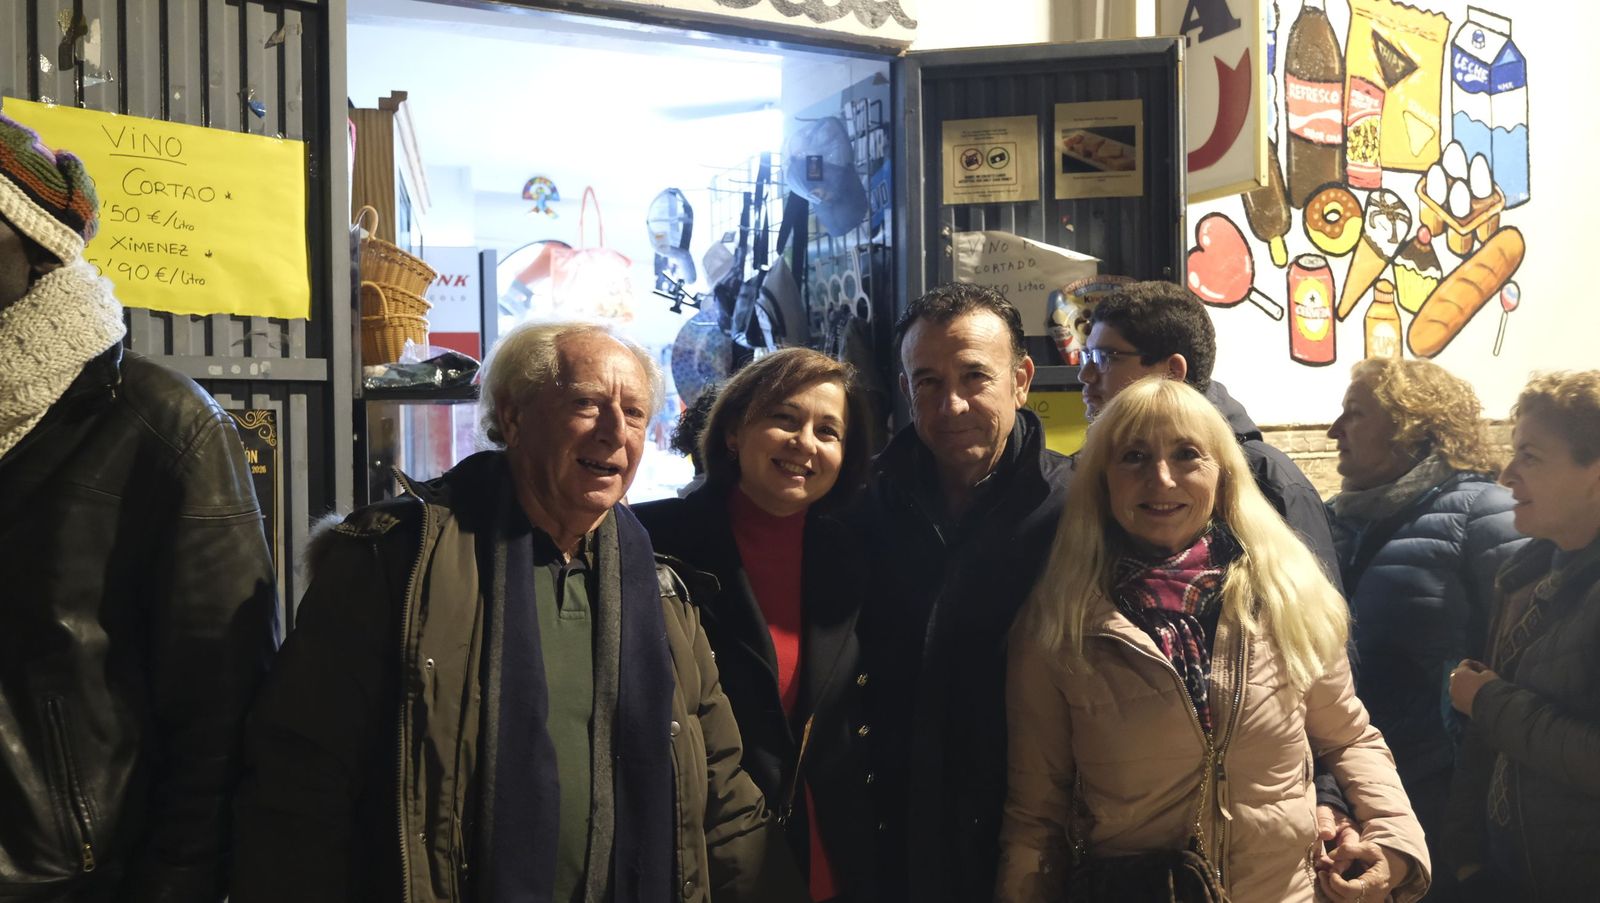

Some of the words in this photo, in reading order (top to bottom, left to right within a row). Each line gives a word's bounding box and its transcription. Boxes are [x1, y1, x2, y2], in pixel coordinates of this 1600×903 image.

[1454, 53, 1490, 80] LECHE
[1289, 82, 1340, 104] REFRESCO
[122, 167, 216, 202] CORTAO
[974, 258, 1037, 275] CORTADO
